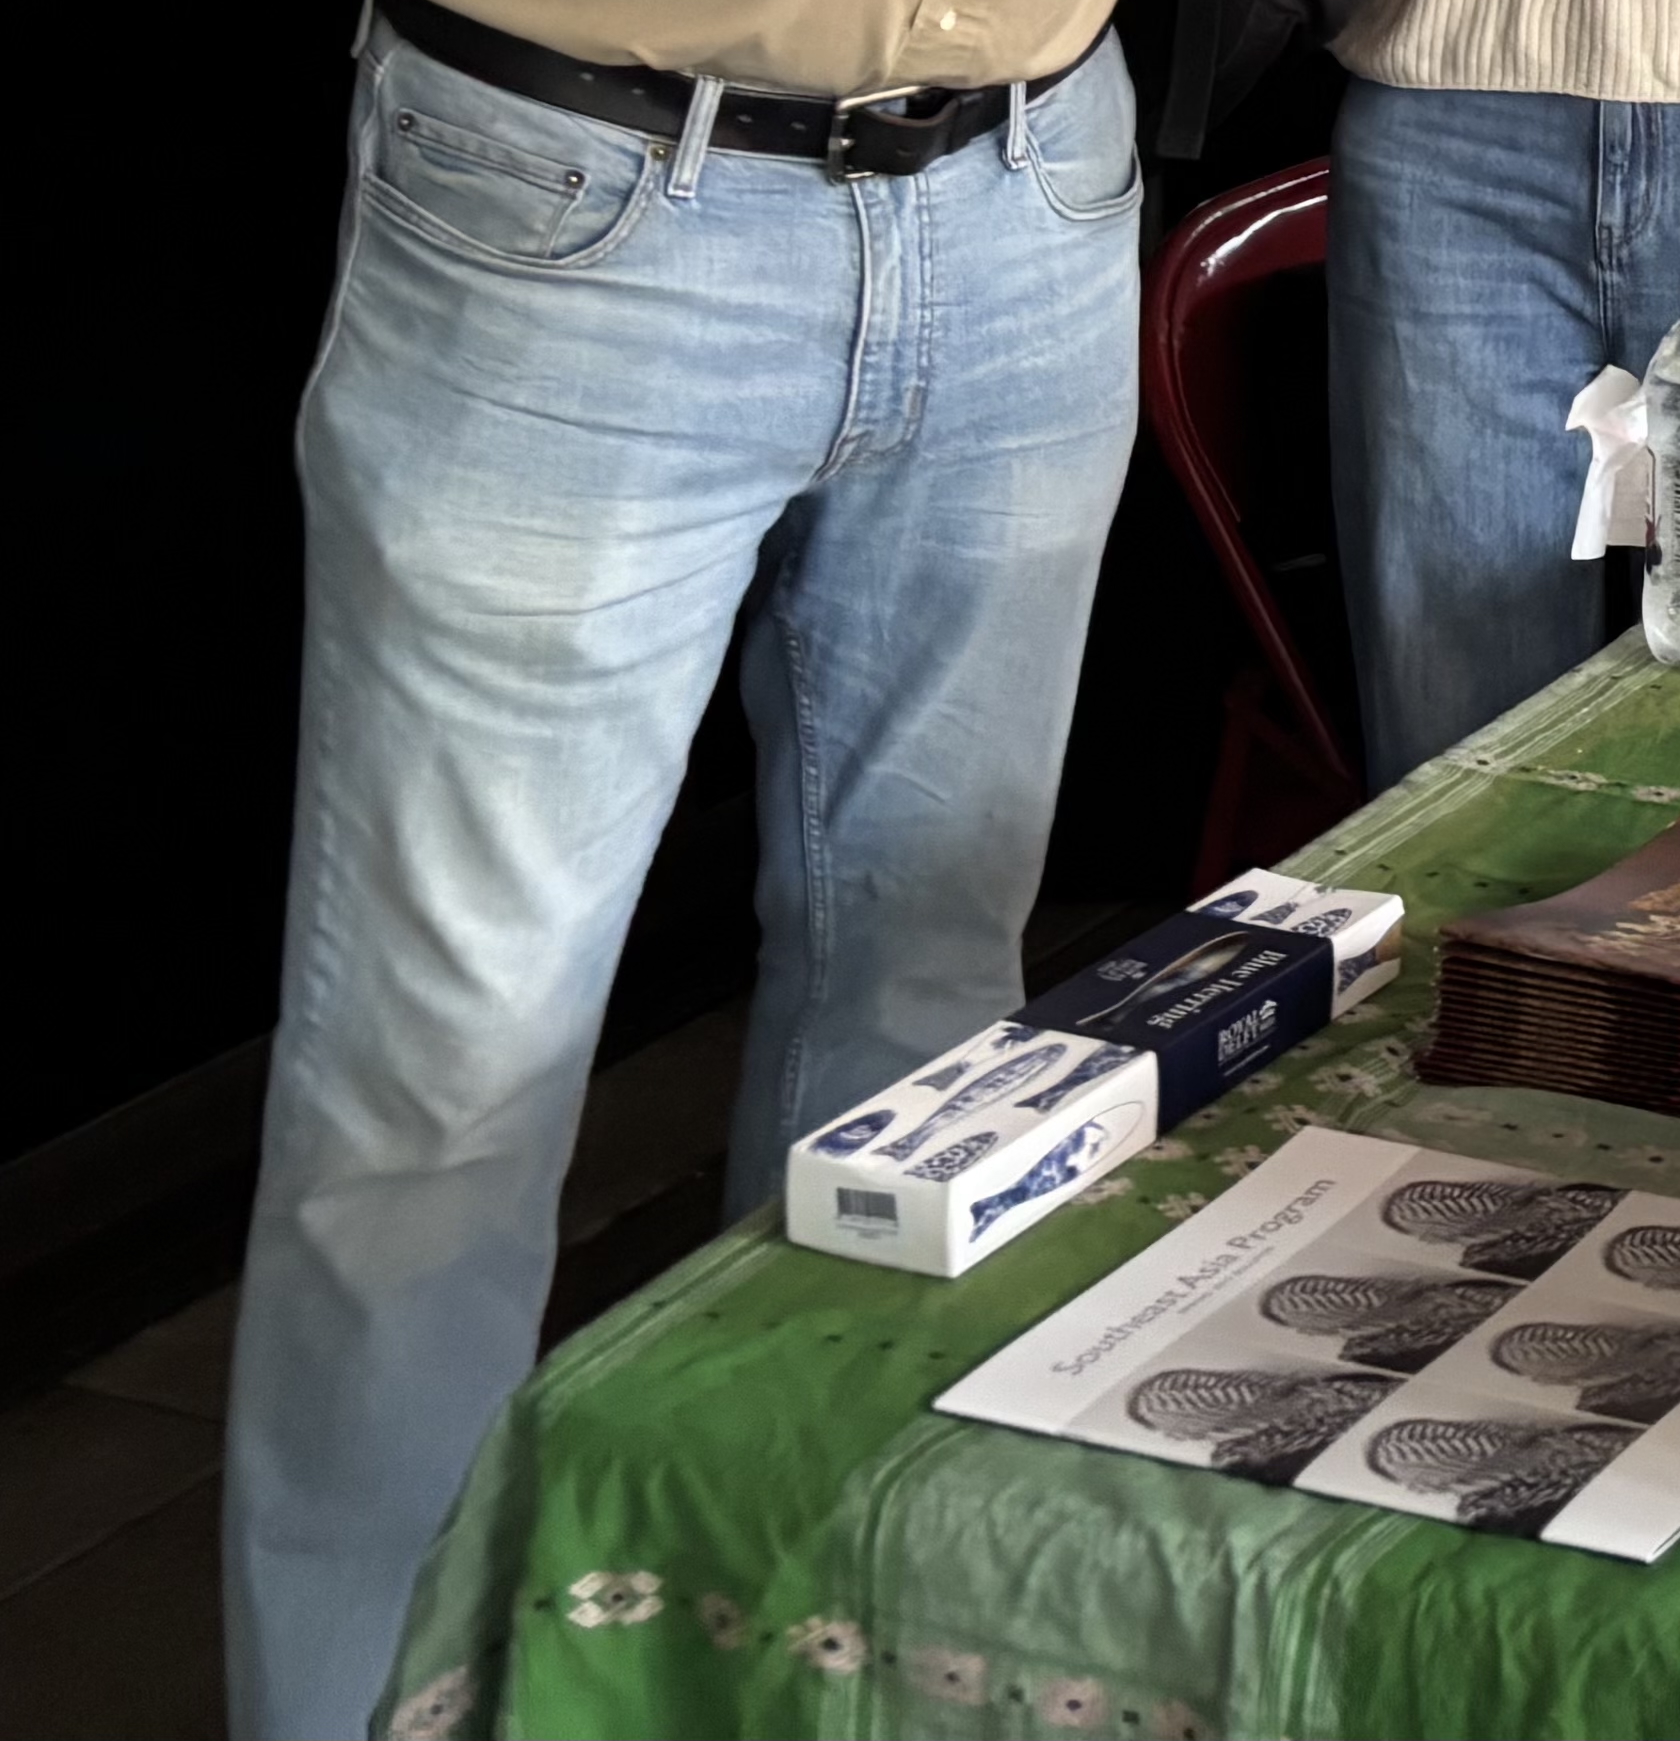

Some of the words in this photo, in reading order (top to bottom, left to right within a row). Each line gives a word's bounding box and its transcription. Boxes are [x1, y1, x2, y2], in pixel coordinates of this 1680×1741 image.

[1231, 949, 1289, 979] Blue
[1146, 978, 1244, 1030] Herring
[1051, 1288, 1189, 1377] Southeast
[1178, 1252, 1238, 1290] Asia
[1228, 1177, 1338, 1251] Program
